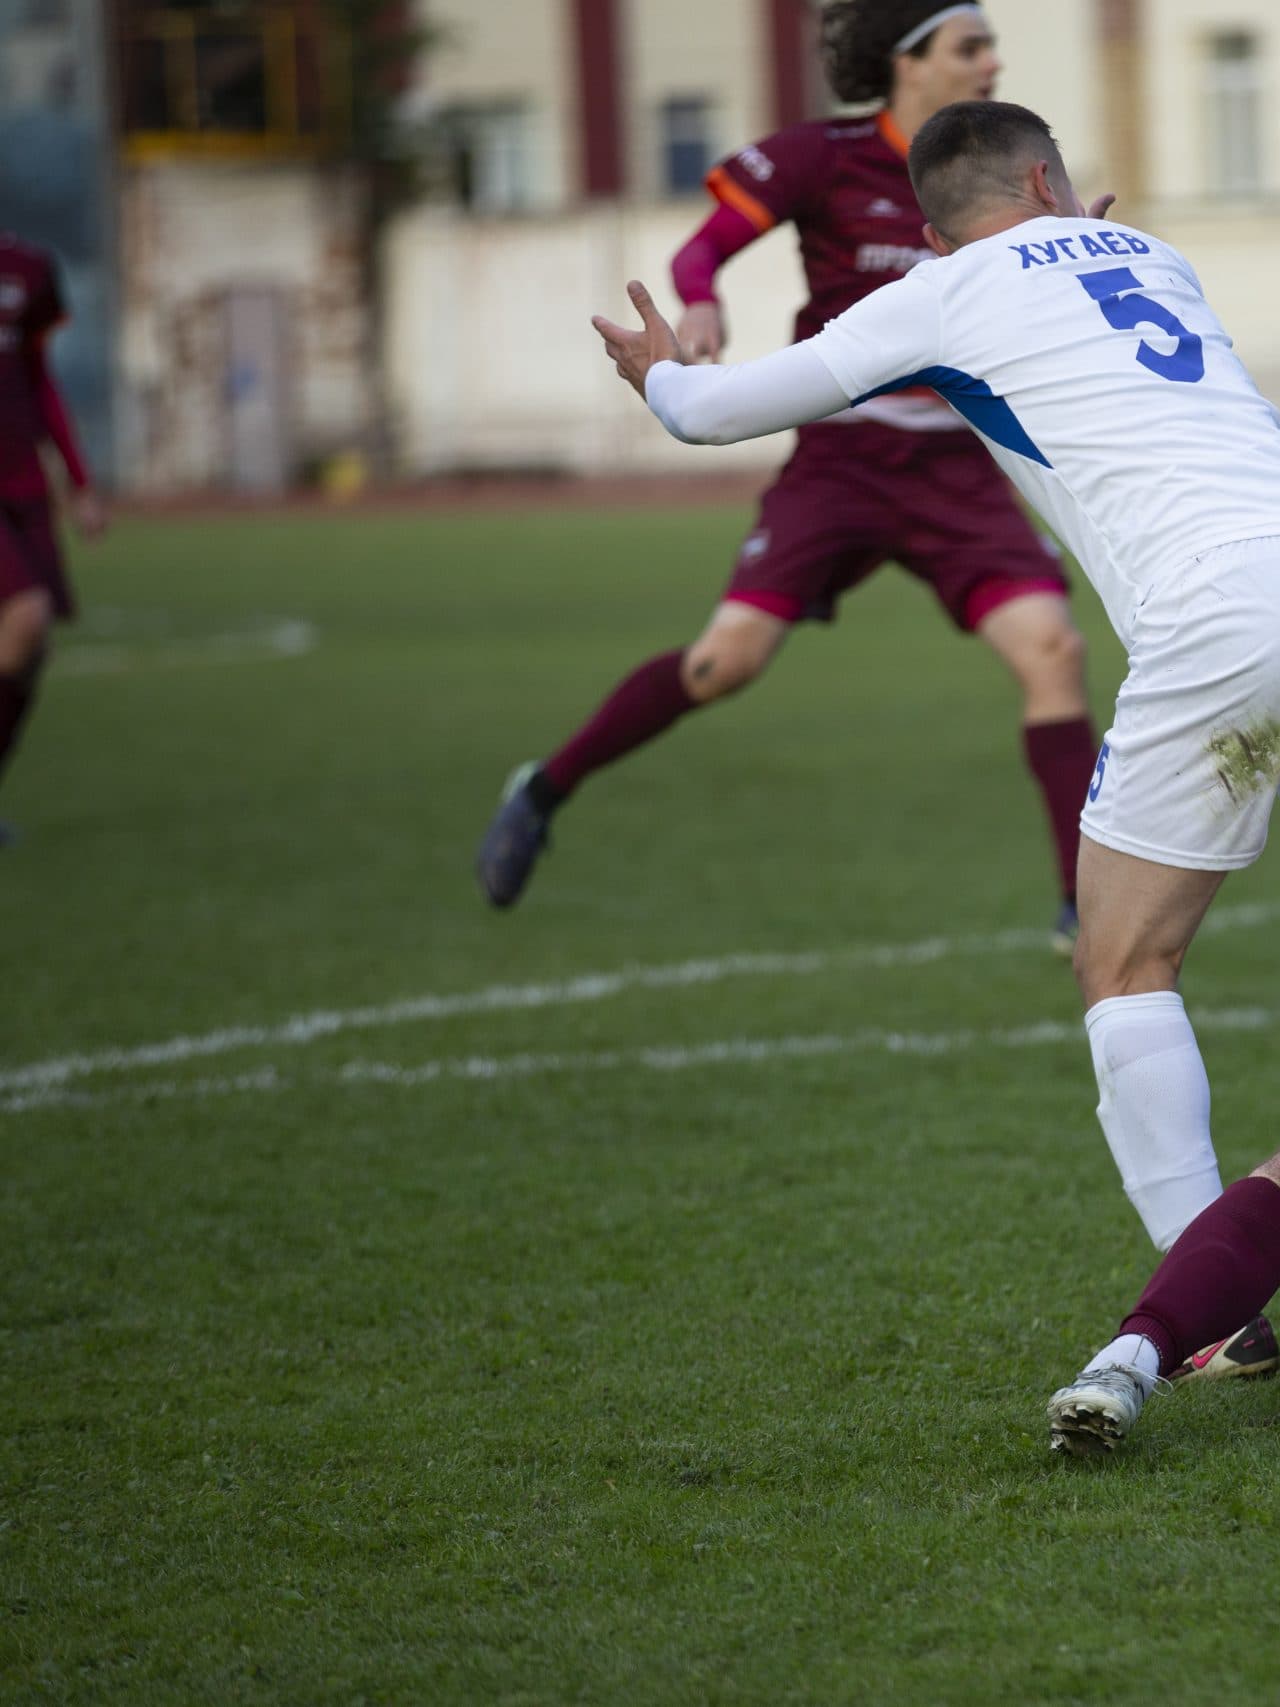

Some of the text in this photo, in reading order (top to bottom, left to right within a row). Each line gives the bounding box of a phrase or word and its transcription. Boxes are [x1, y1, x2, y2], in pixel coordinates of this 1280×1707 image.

[1008, 231, 1151, 269] ХУГАЕВ
[1075, 266, 1205, 384] 5
[1089, 741, 1110, 803] 5
